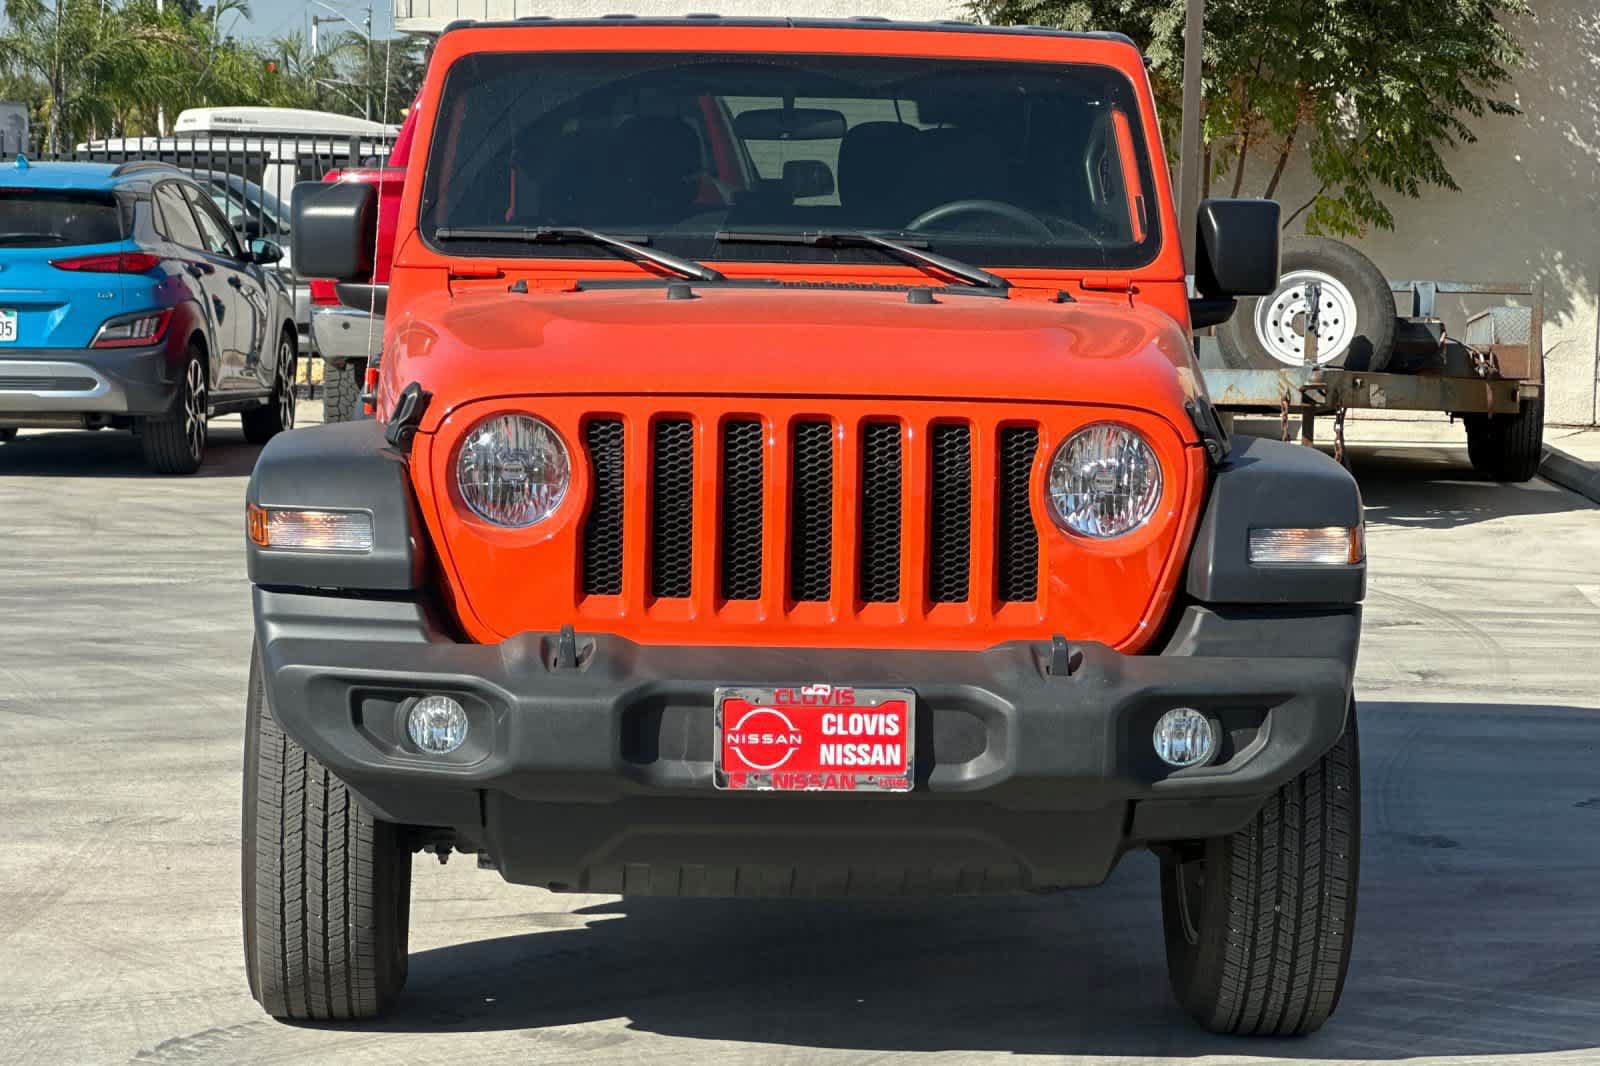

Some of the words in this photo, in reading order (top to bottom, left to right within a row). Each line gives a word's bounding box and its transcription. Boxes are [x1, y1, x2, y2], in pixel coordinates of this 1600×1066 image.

[822, 713, 900, 736] CLOVIS
[727, 734, 802, 744] NISSAN
[820, 743, 901, 766] NISSAN
[772, 773, 856, 790] NISSAN
